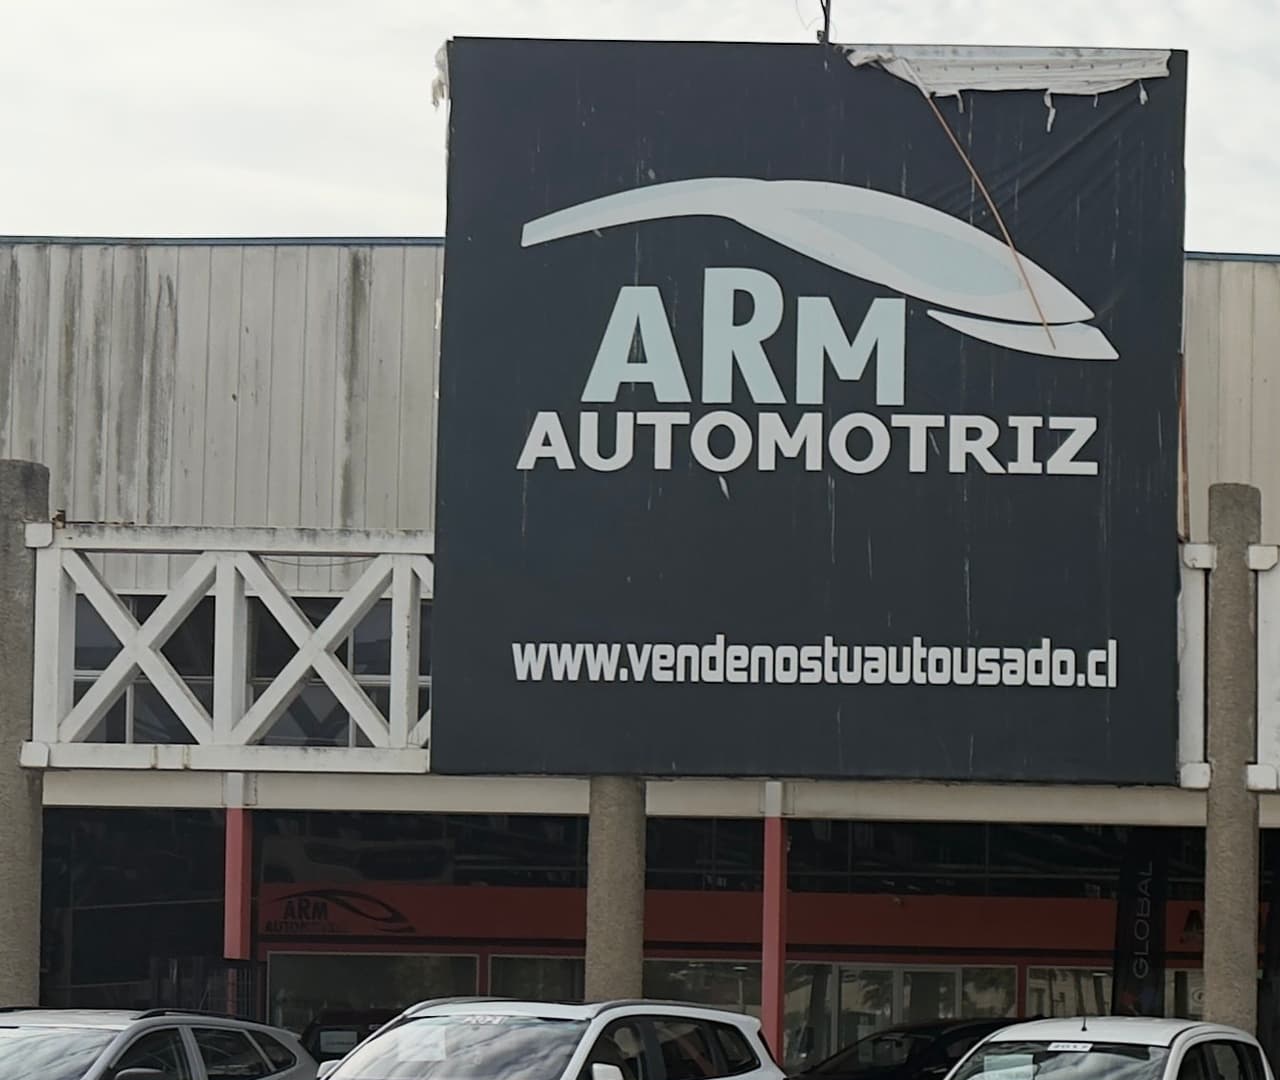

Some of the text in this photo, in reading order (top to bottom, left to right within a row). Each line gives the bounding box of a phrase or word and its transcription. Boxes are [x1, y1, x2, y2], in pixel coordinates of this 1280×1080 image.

[580, 267, 906, 406] ARM
[516, 411, 1099, 476] AUTOMOTRIZ
[512, 634, 1118, 689] www.vendenostuautousado.cl
[1133, 861, 1153, 979] GLOBAL
